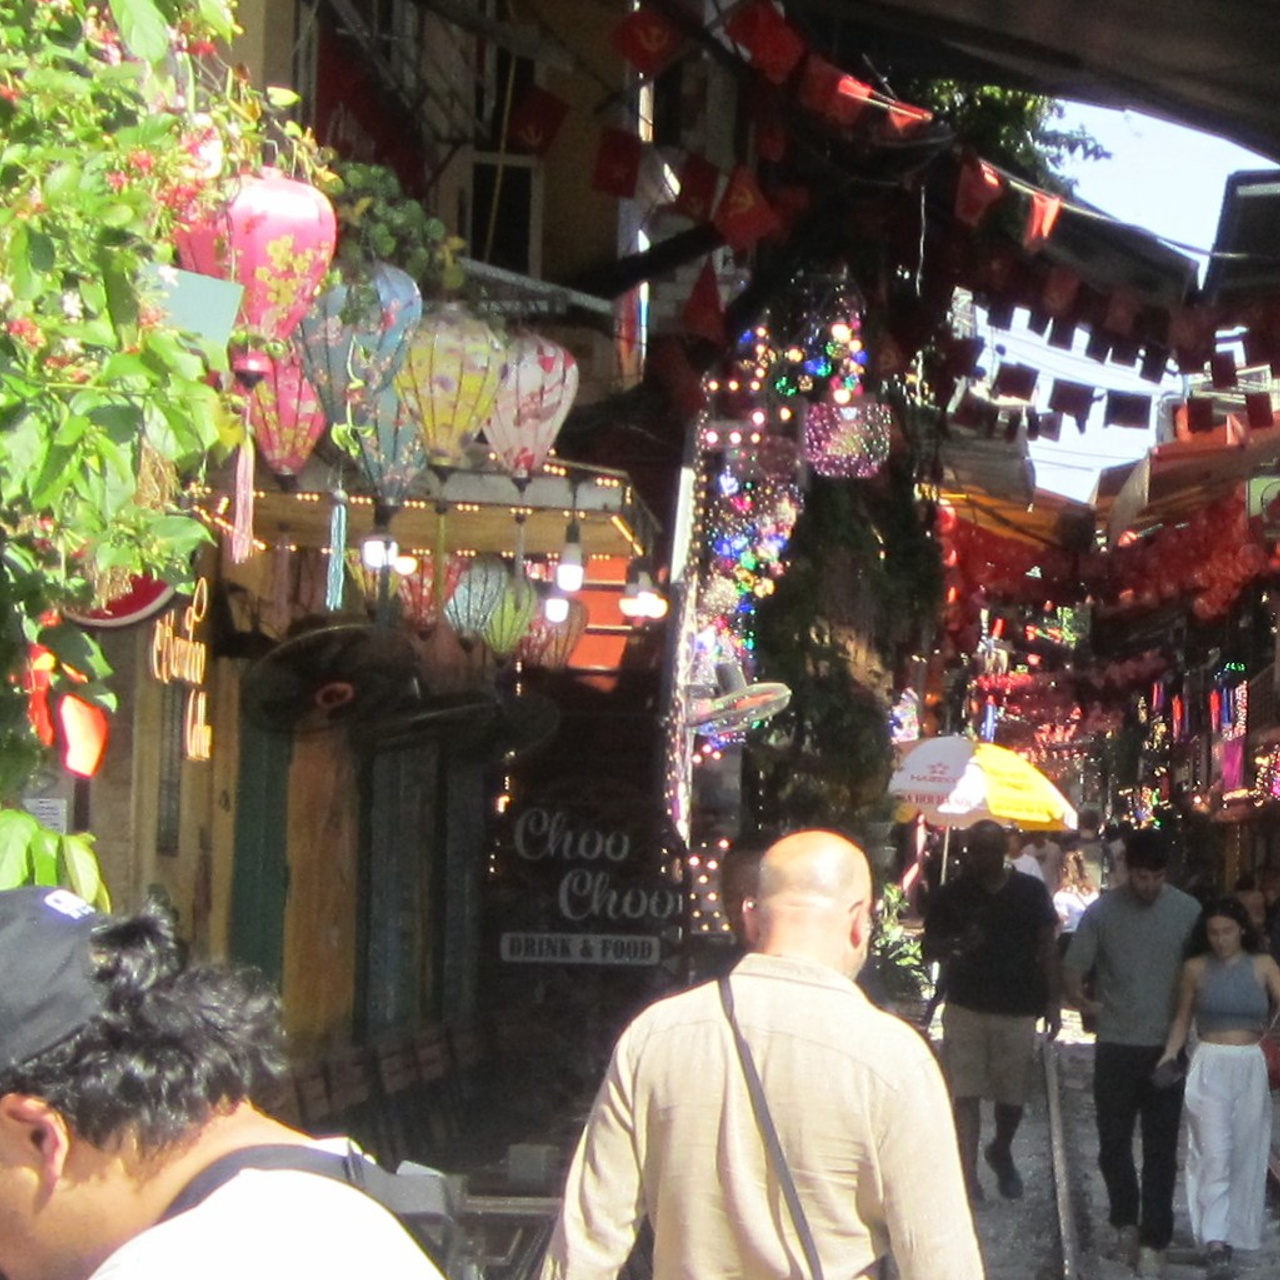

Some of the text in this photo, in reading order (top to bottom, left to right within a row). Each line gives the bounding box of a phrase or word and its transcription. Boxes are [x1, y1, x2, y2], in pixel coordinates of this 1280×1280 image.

[513, 807, 631, 860] Choo
[558, 869, 675, 920] Choo
[508, 936, 652, 960] DRINK & FOOD
